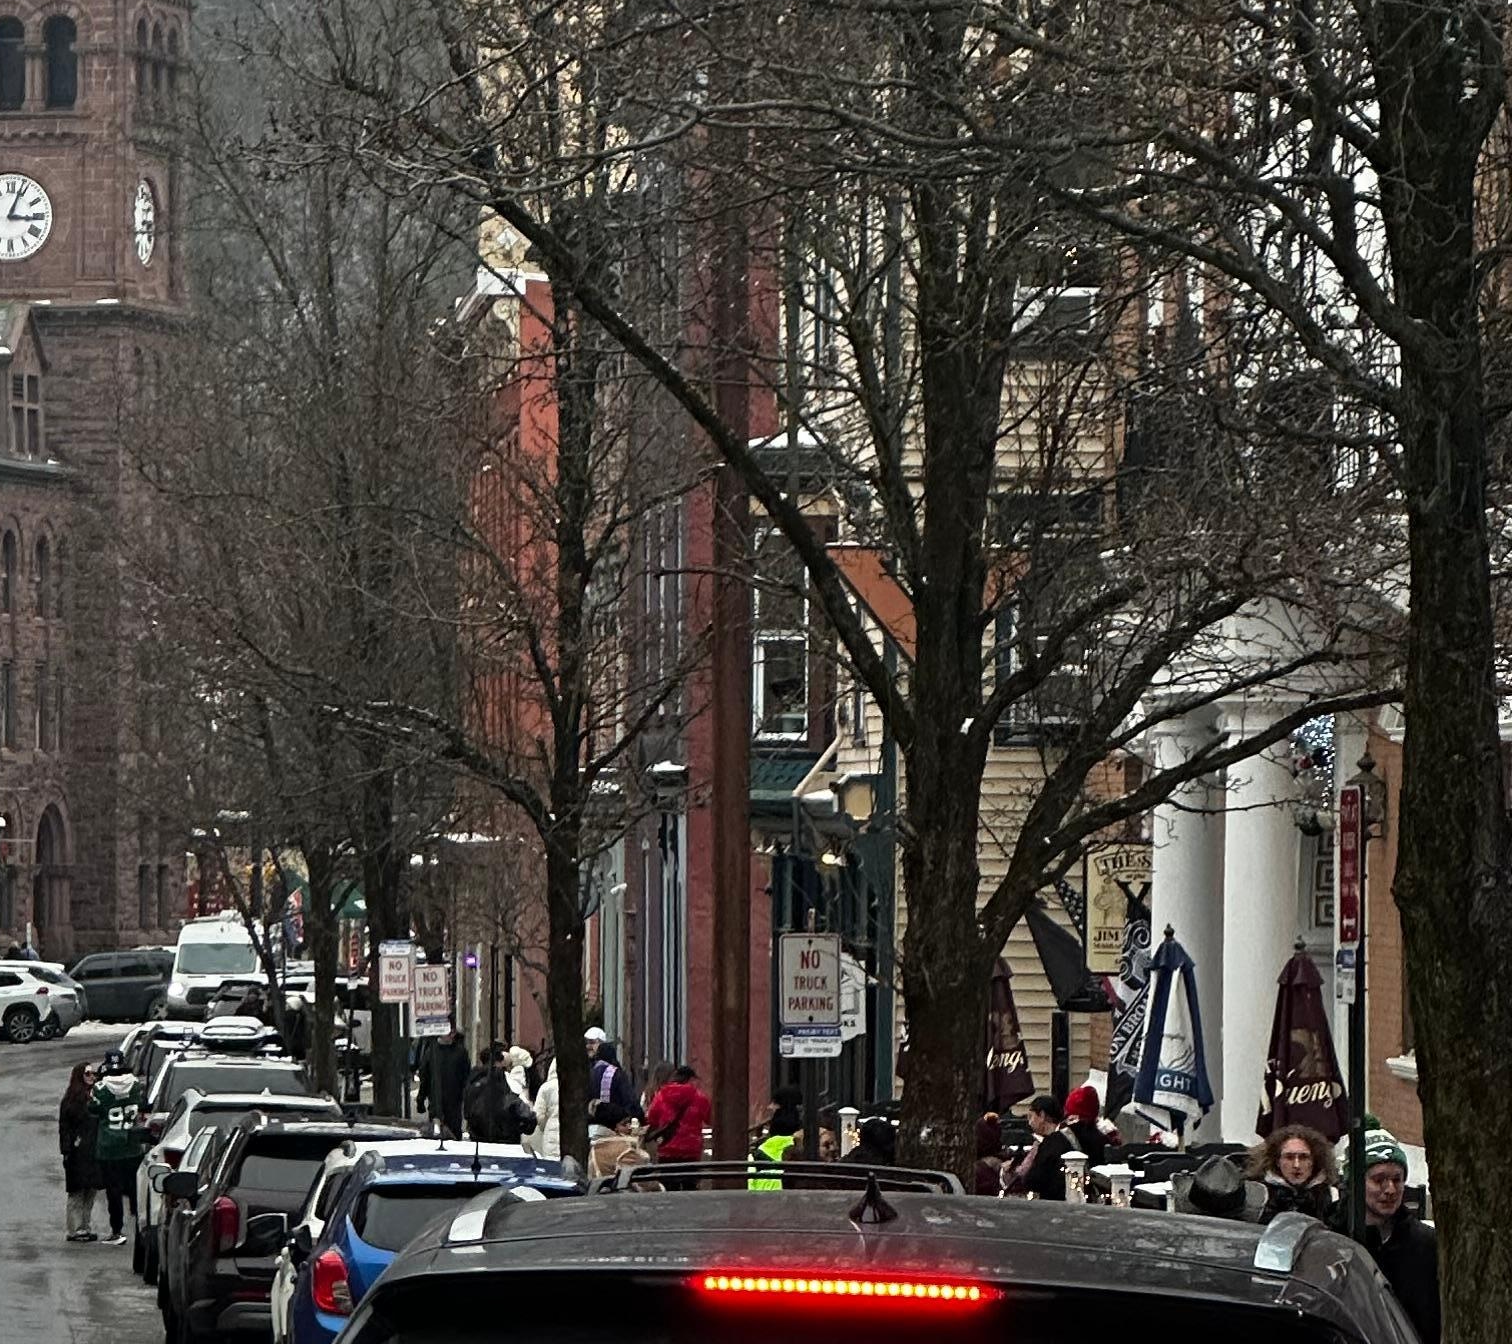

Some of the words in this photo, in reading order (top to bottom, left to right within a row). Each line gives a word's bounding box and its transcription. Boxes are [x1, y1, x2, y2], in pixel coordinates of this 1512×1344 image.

[389, 960, 403, 971] NO
[800, 950, 821, 970] NO
[422, 971, 438, 983] NO
[794, 975, 828, 991] TRUCK
[418, 986, 443, 996] TRUCK
[788, 997, 834, 1012] PARKING
[1108, 1036, 1128, 1056] ON
[1121, 997, 1149, 1035] BRO
